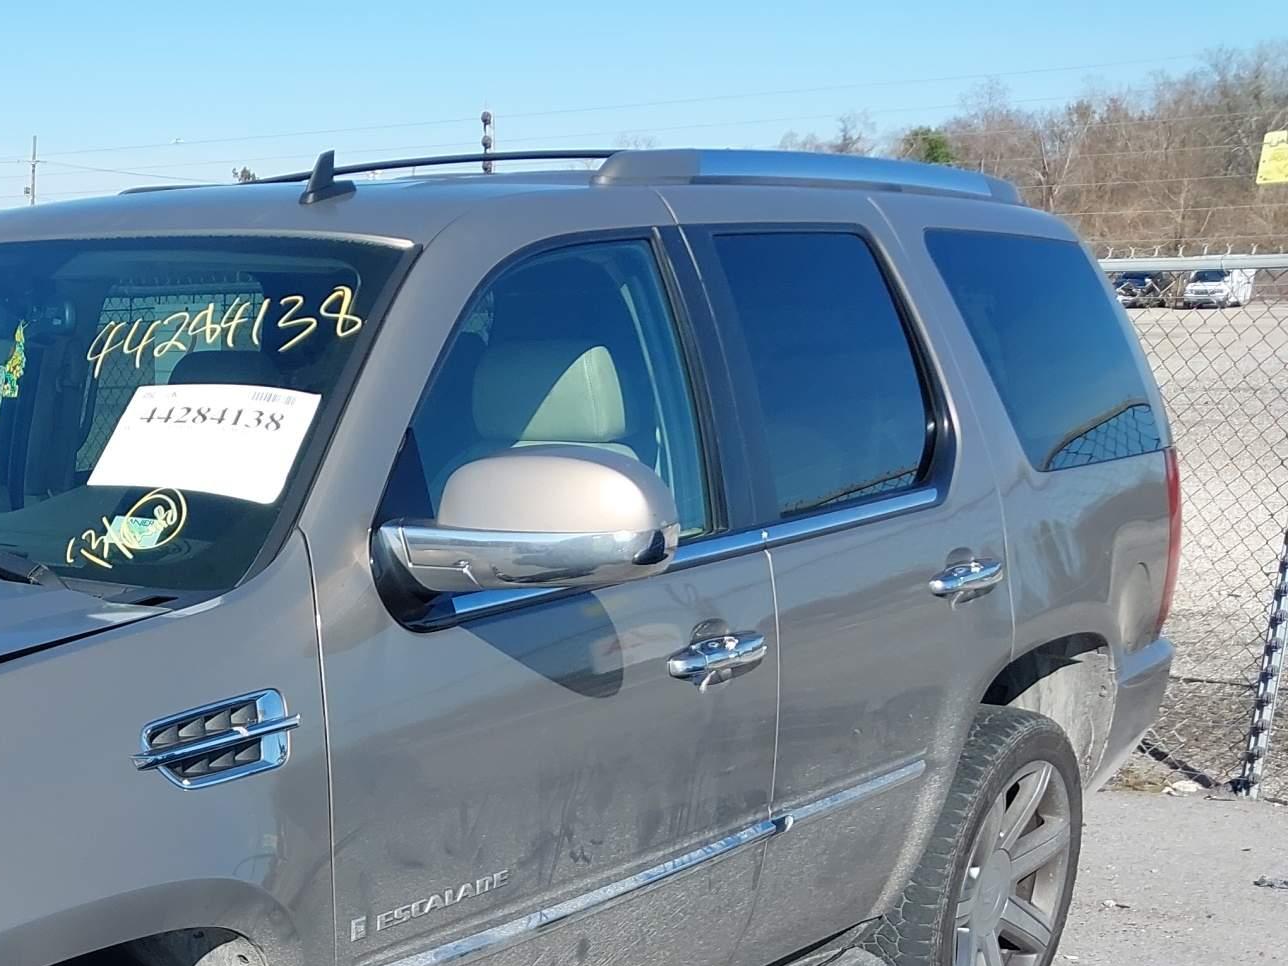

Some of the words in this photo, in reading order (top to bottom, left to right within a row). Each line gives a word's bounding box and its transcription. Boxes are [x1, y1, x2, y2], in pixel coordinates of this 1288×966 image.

[86, 285, 363, 379] 44284138
[139, 405, 285, 432] 44284138
[376, 868, 510, 932] ESCALADE
